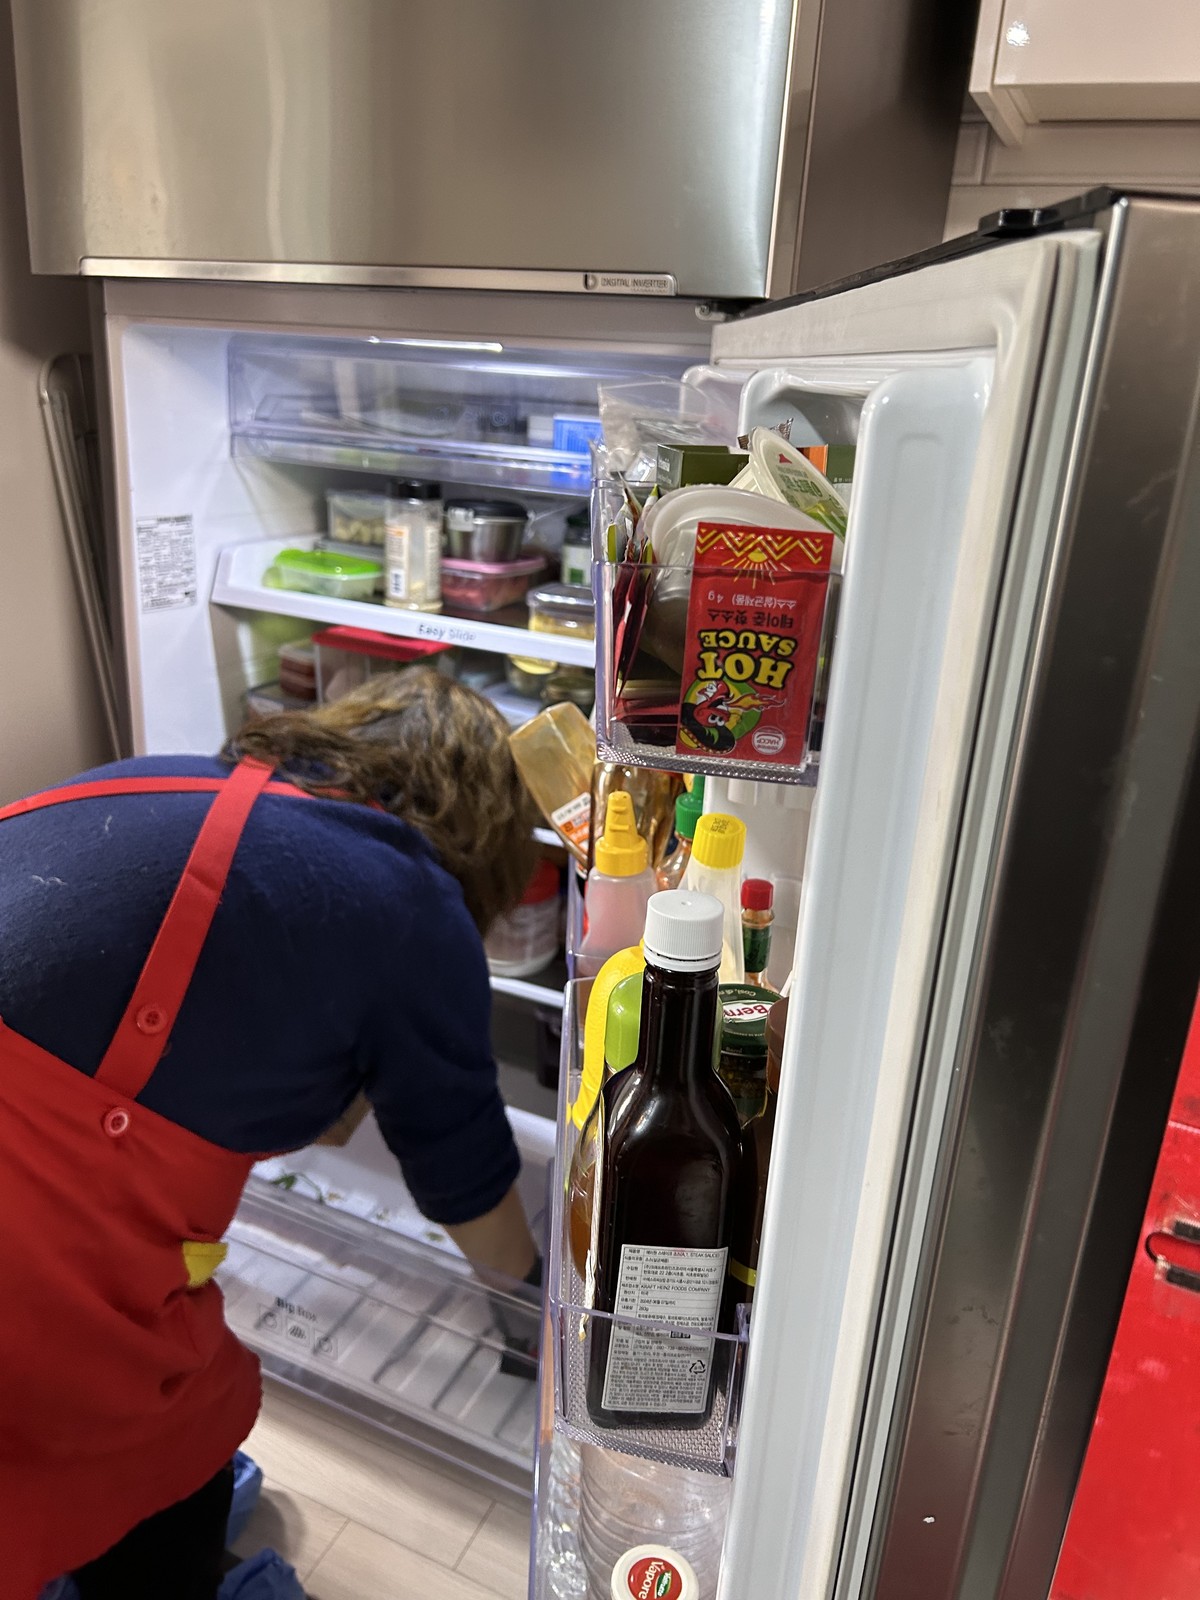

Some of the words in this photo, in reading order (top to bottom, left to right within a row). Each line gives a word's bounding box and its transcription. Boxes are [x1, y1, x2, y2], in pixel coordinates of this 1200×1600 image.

[633, 279, 669, 289] INVERTER
[731, 593, 797, 610] 소스(살균제품)
[707, 608, 748, 625] 핫소스
[752, 610, 794, 629] 테이준
[698, 629, 796, 657] SAUCE
[696, 650, 794, 690] HOT
[756, 737, 780, 746] HACCP
[722, 1004, 769, 1018] Bern
[638, 1561, 664, 1600] Vapore
